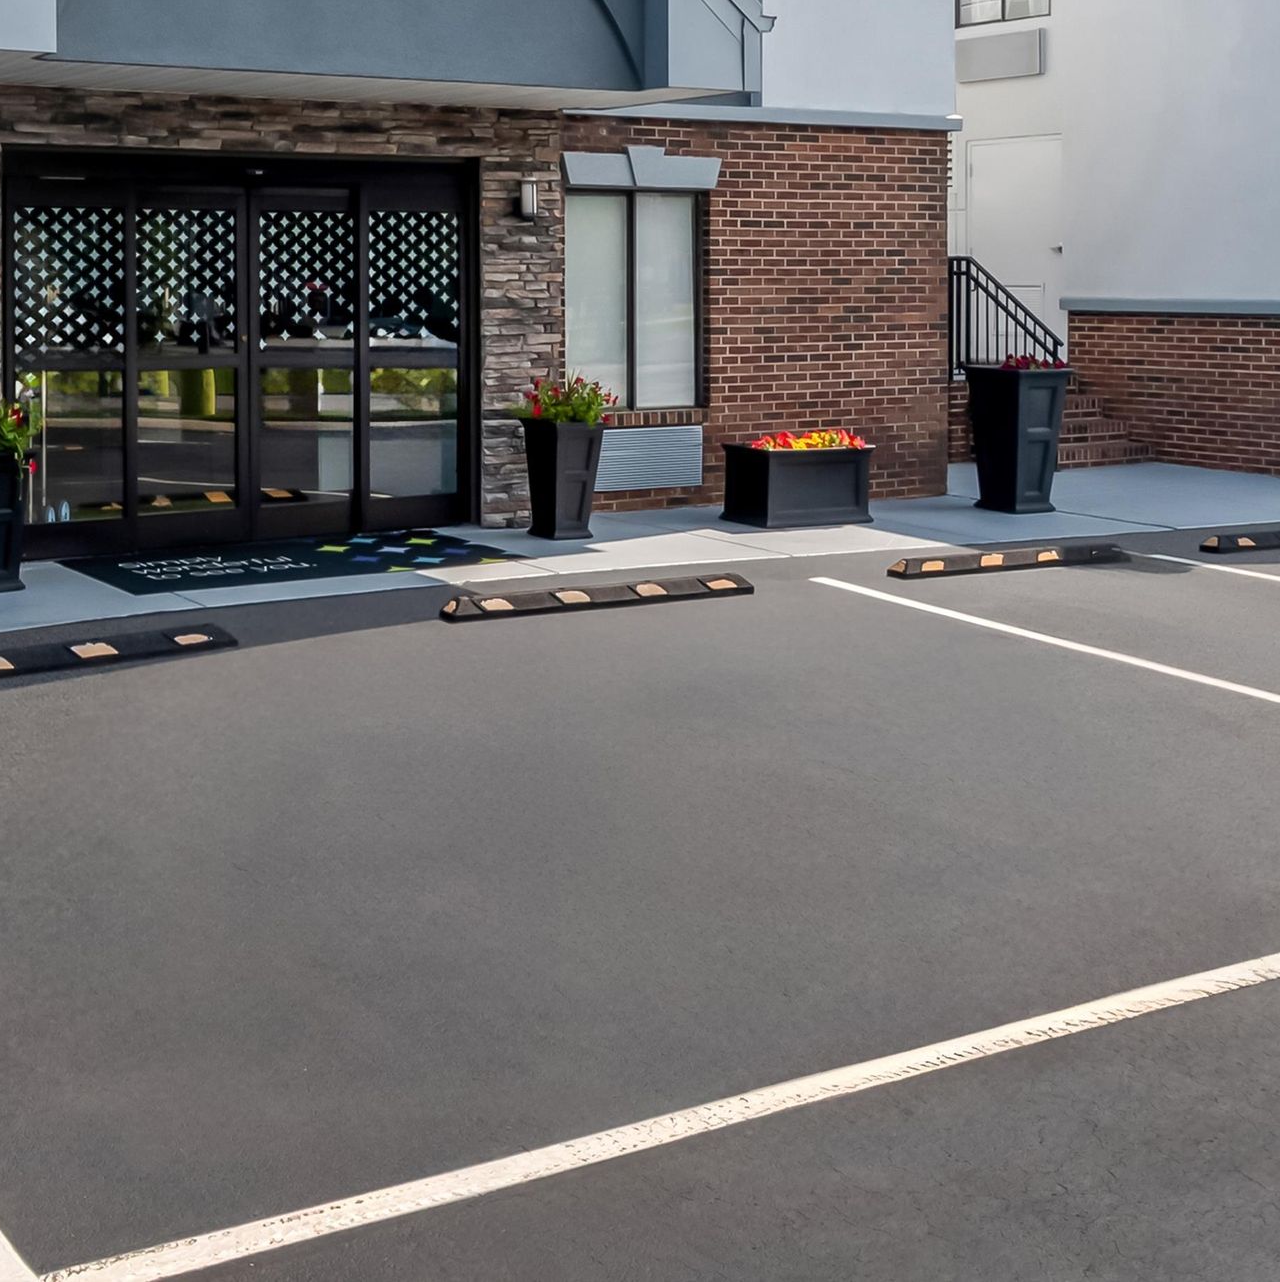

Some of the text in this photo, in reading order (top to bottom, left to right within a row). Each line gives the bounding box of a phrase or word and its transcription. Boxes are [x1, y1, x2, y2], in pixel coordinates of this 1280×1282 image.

[118, 556, 221, 569] Simply
[131, 555, 293, 575] wonderful
[189, 568, 245, 577] see
